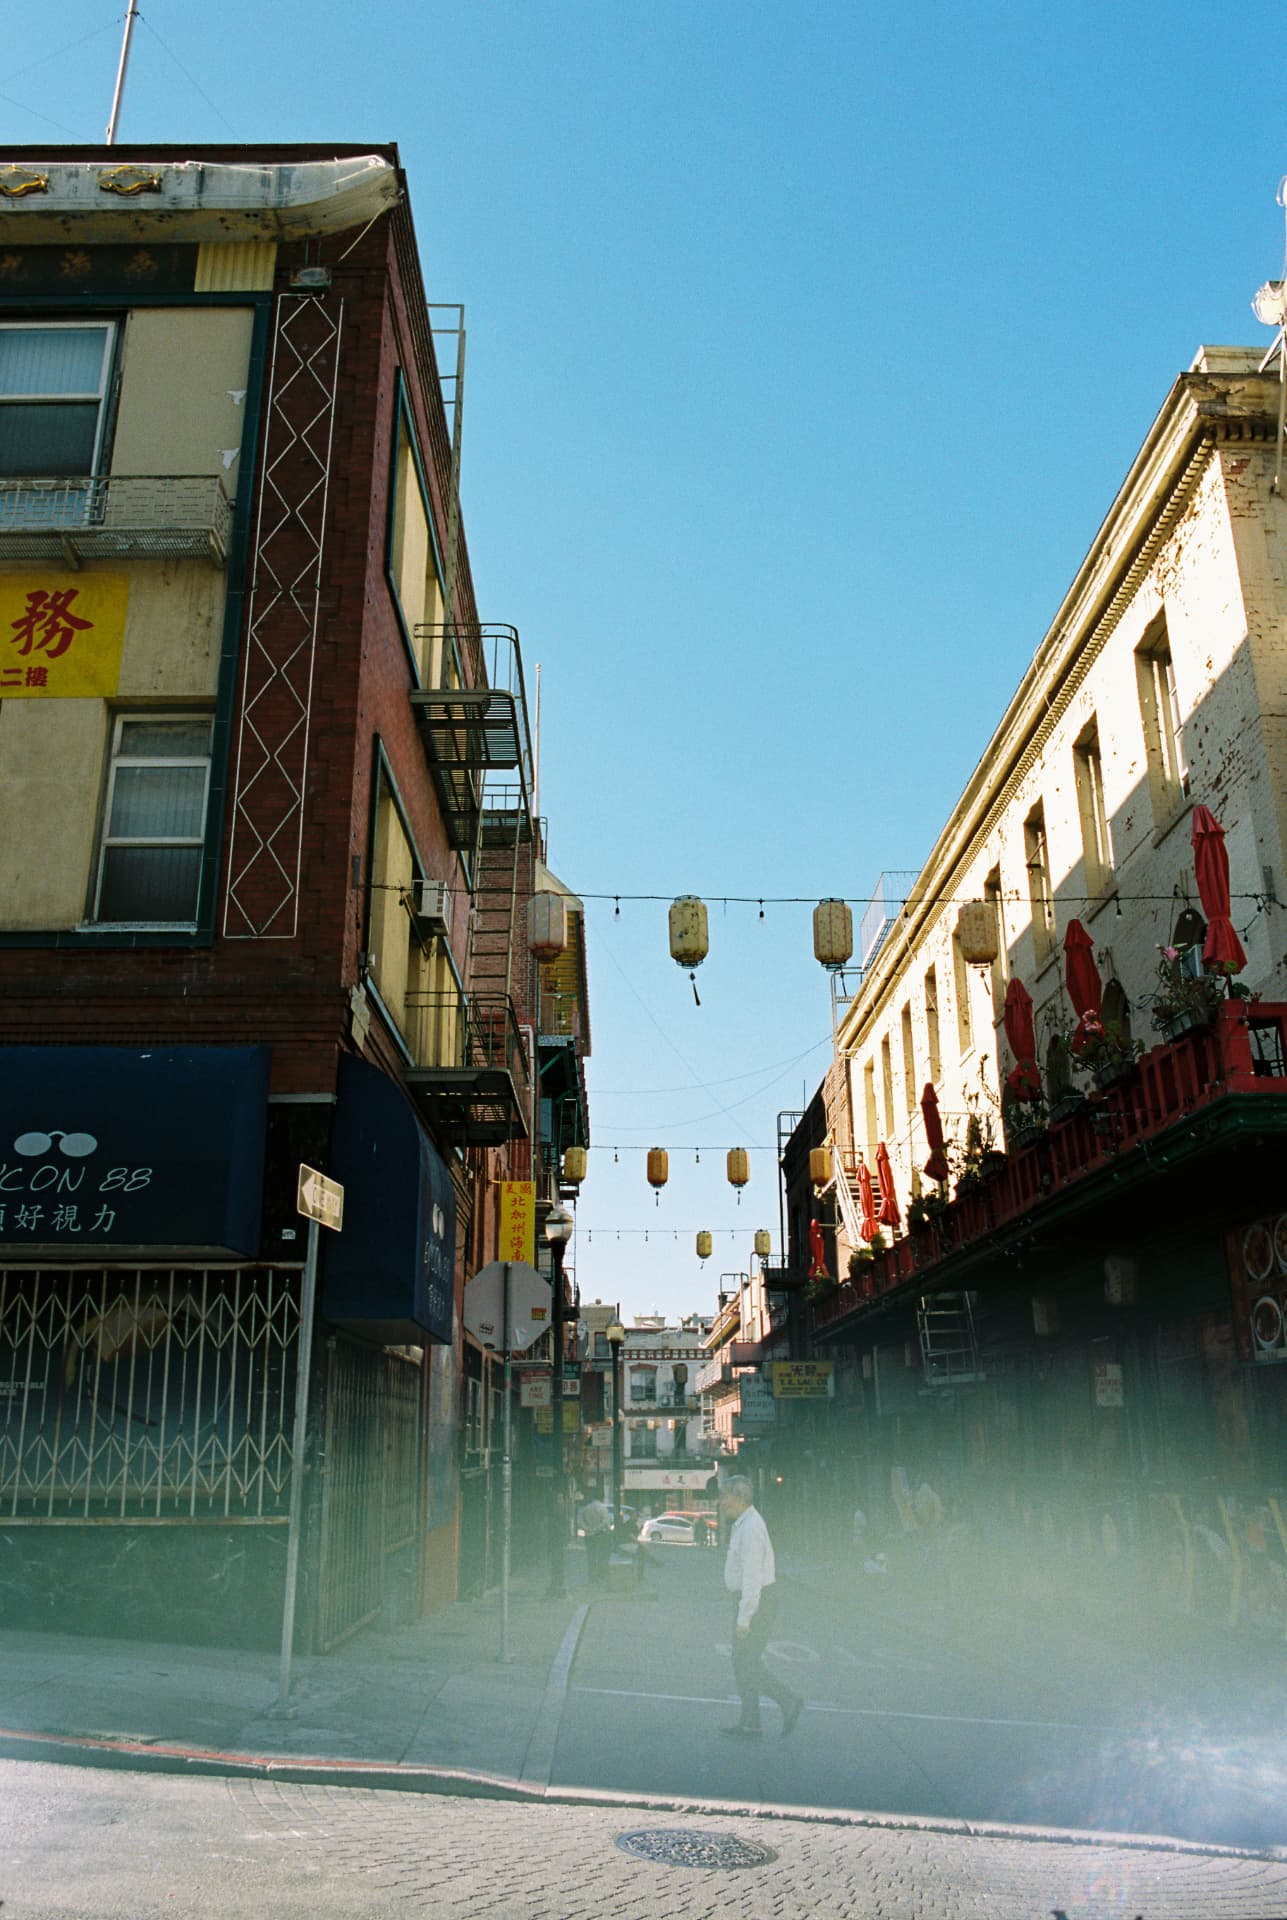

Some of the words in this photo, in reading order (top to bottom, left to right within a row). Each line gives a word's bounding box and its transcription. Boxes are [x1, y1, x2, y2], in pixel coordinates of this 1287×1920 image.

[10, 588, 95, 658] 務
[0, 667, 48, 687] 二樓
[99, 1168, 152, 1191] 88
[0, 1203, 116, 1233] 好視力
